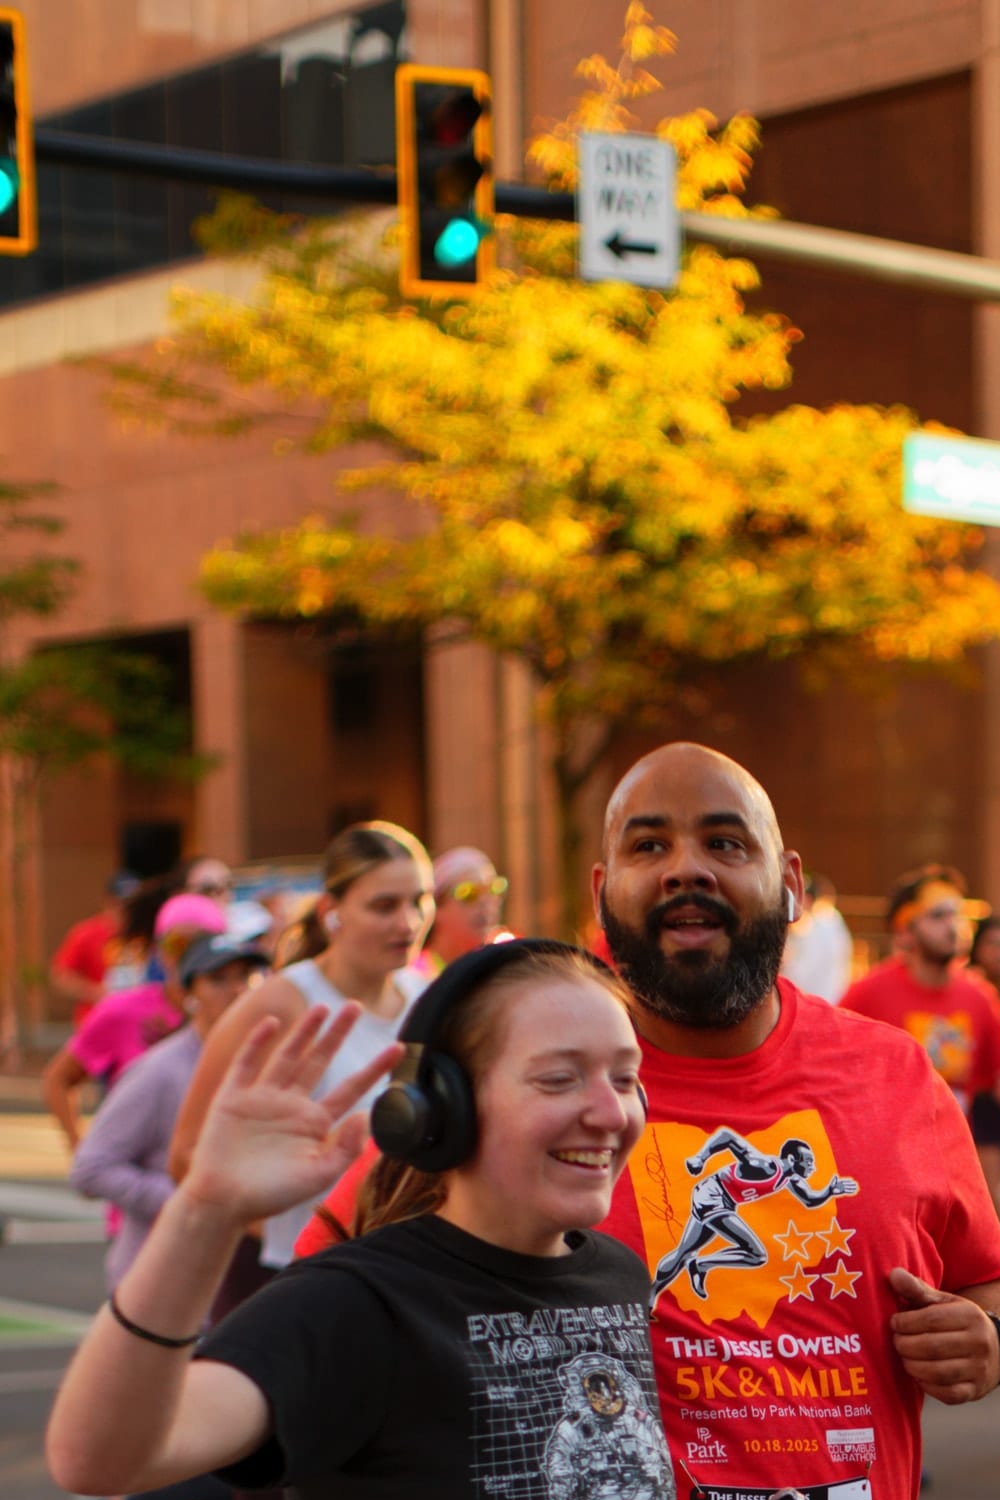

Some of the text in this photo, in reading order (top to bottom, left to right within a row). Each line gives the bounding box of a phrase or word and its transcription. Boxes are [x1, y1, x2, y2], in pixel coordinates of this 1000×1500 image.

[665, 1333, 862, 1362] THE JESSE OWENS
[680, 1405, 748, 1420] Presented
[751, 1404, 767, 1420] by
[769, 1403, 797, 1417] Park
[844, 1403, 873, 1417] Bank
[685, 1442, 728, 1459] Park
[743, 1439, 819, 1453] 10.18.2025
[830, 1452, 877, 1463] MARATHON
